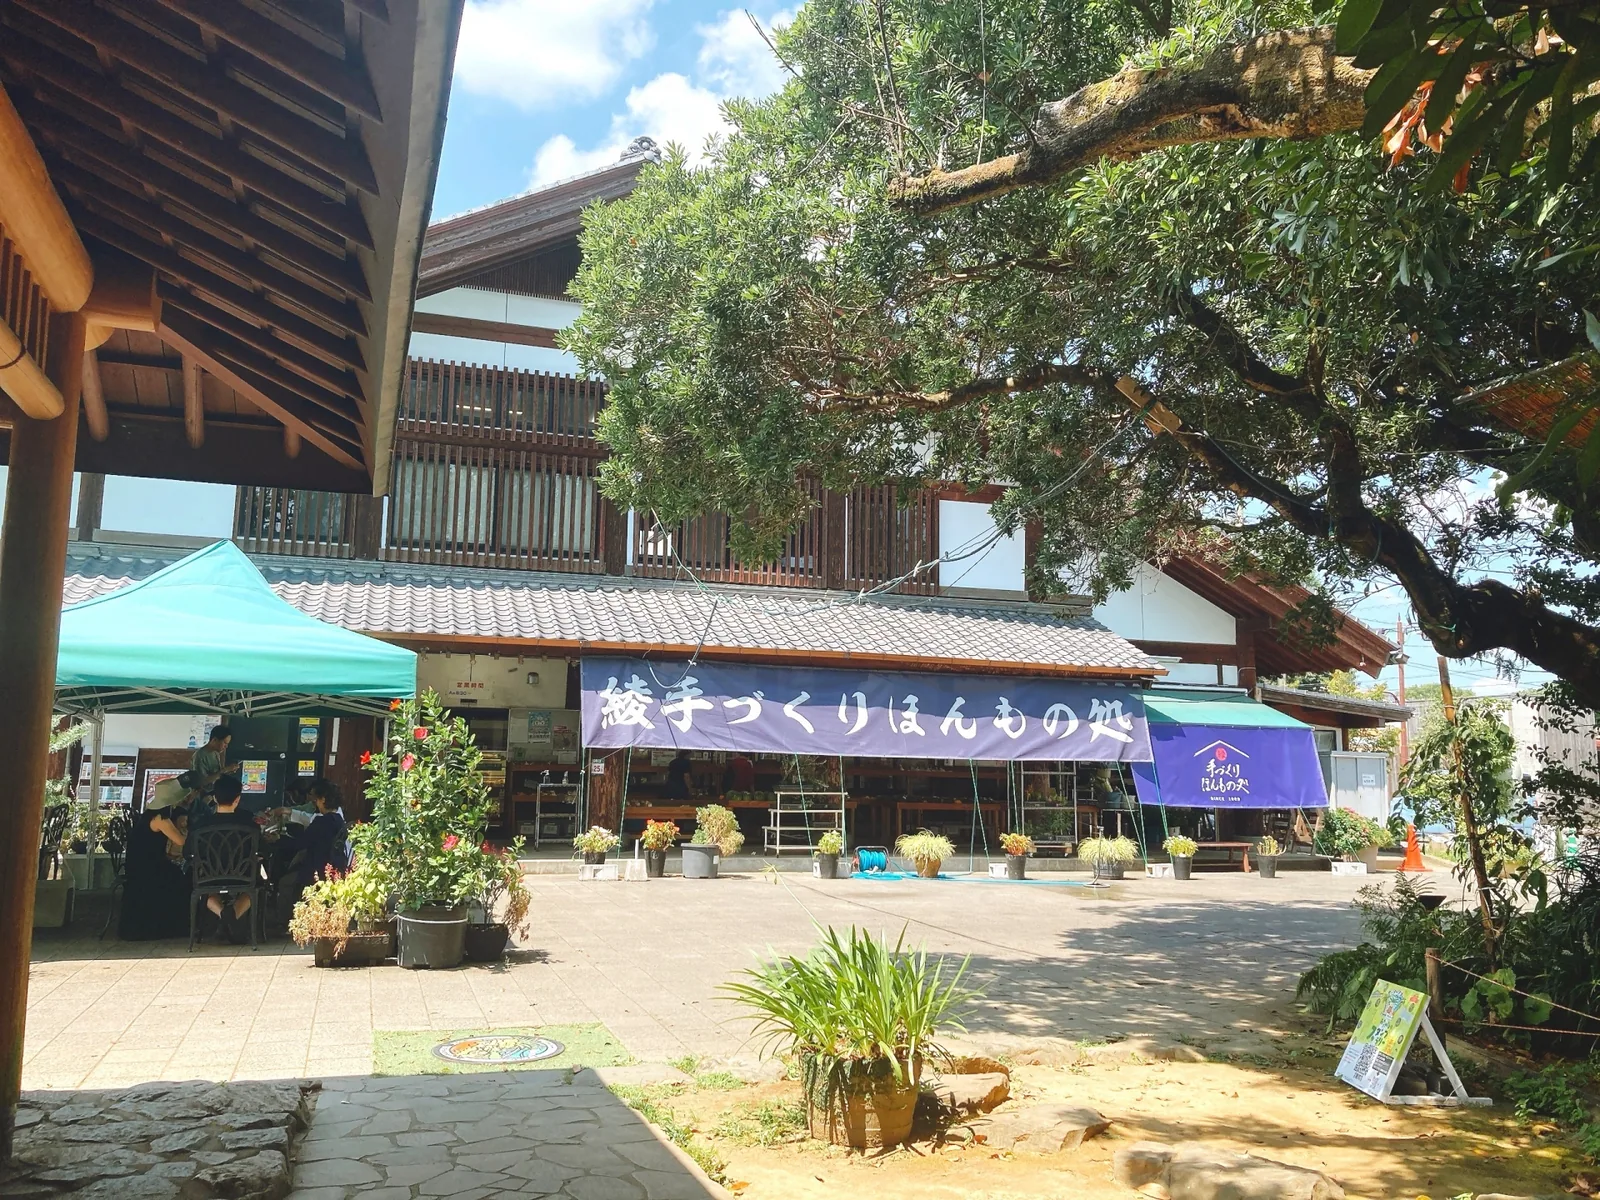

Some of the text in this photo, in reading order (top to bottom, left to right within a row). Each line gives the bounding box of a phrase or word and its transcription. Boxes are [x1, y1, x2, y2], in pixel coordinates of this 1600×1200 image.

[599, 673, 1135, 744] 綾手づくりほんもの処
[1206, 758, 1240, 778] 手づくり
[1201, 777, 1250, 795] ほんもの処
